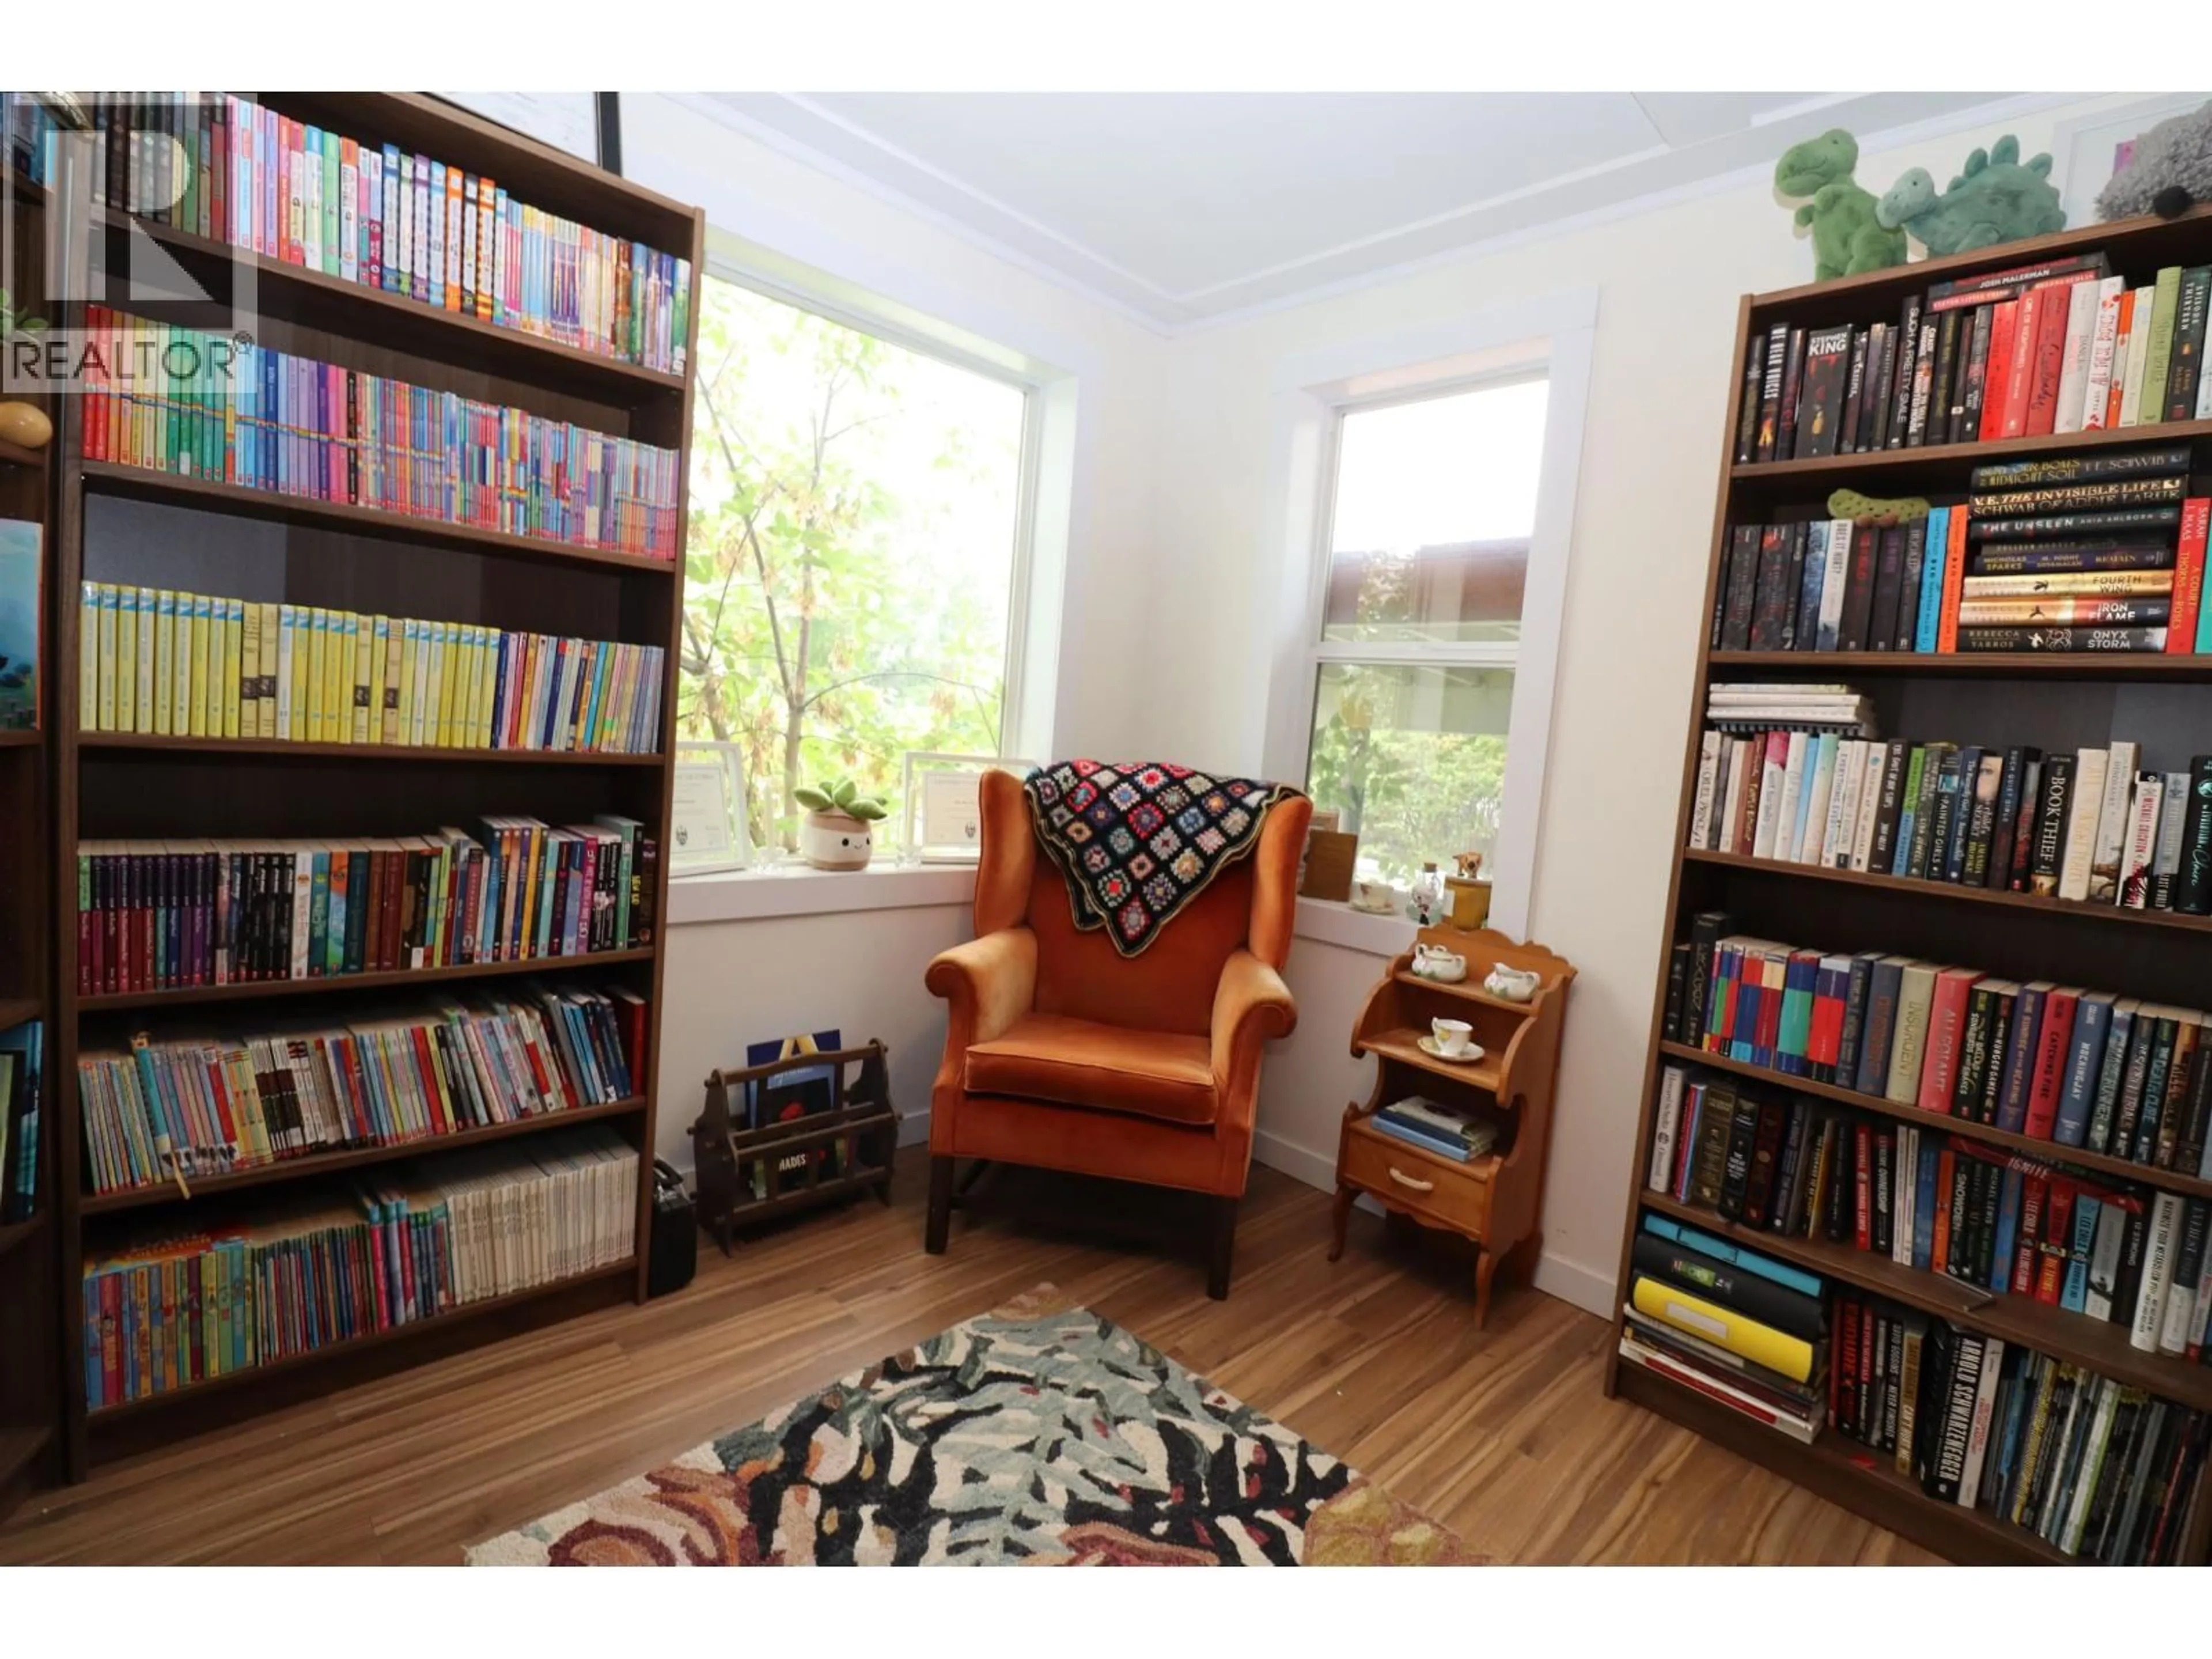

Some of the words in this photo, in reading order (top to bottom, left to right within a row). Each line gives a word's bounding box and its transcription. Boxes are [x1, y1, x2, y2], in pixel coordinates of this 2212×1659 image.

[1980, 279, 2001, 288] JOSH
[2002, 269, 2050, 285] MALERMAN
[2181, 282, 2194, 331] THIRTEEN
[1907, 307, 1918, 338] SUCH
[1809, 339, 1847, 357] KING
[1907, 339, 1915, 349] A
[1901, 351, 1914, 390] PRETTY
[1897, 393, 1908, 423] SMILE
[2045, 469, 2076, 481] SOIL
[2002, 493, 2031, 504] THE
[2036, 484, 2118, 500] INVISIBLE
[2122, 480, 2161, 493] LIFE
[2067, 495, 2116, 510] ADDIE
[1974, 503, 2035, 516] SCHWAB
[2196, 507, 2208, 539] SARAH
[1982, 522, 2008, 532] THE
[2014, 517, 2074, 531] UNSEEN
[2183, 514, 2194, 540] MAAS
[1983, 556, 2027, 564] NICHOLAS
[1987, 562, 2024, 571] SPARKS
[2177, 551, 2189, 588] THORNS
[2093, 575, 2141, 585] FOURTH
[2100, 584, 2133, 594] WING
[2188, 575, 2199, 607] COURT
[2088, 612, 2135, 621] FLAME
[2099, 603, 2128, 612] IRON
[2172, 601, 2183, 630] ROSES
[2088, 639, 2130, 649] STORM
[2093, 630, 2128, 639] ONYX
[2047, 777, 2066, 817] BOOK
[1937, 799, 1949, 836] PAINTED
[1933, 839, 1942, 863] GIRLS
[2040, 819, 2059, 861] THIEF
[2191, 849, 2210, 886] Claire
[2043, 1031, 2059, 1076] CATCHING
[2071, 1041, 2091, 1101] MOCKINGJAY
[2147, 1060, 2165, 1092] DEATH
[2040, 1078, 2052, 1099] FIRE
[2143, 1094, 2159, 1125] CURE
[1952, 1173, 1967, 1231] SNOWDEN
[1843, 1303, 1858, 1376] ENDURE
[1956, 1338, 1983, 1383] ARNOLD
[1938, 1384, 1976, 1482] SCHWARZENEGGER
